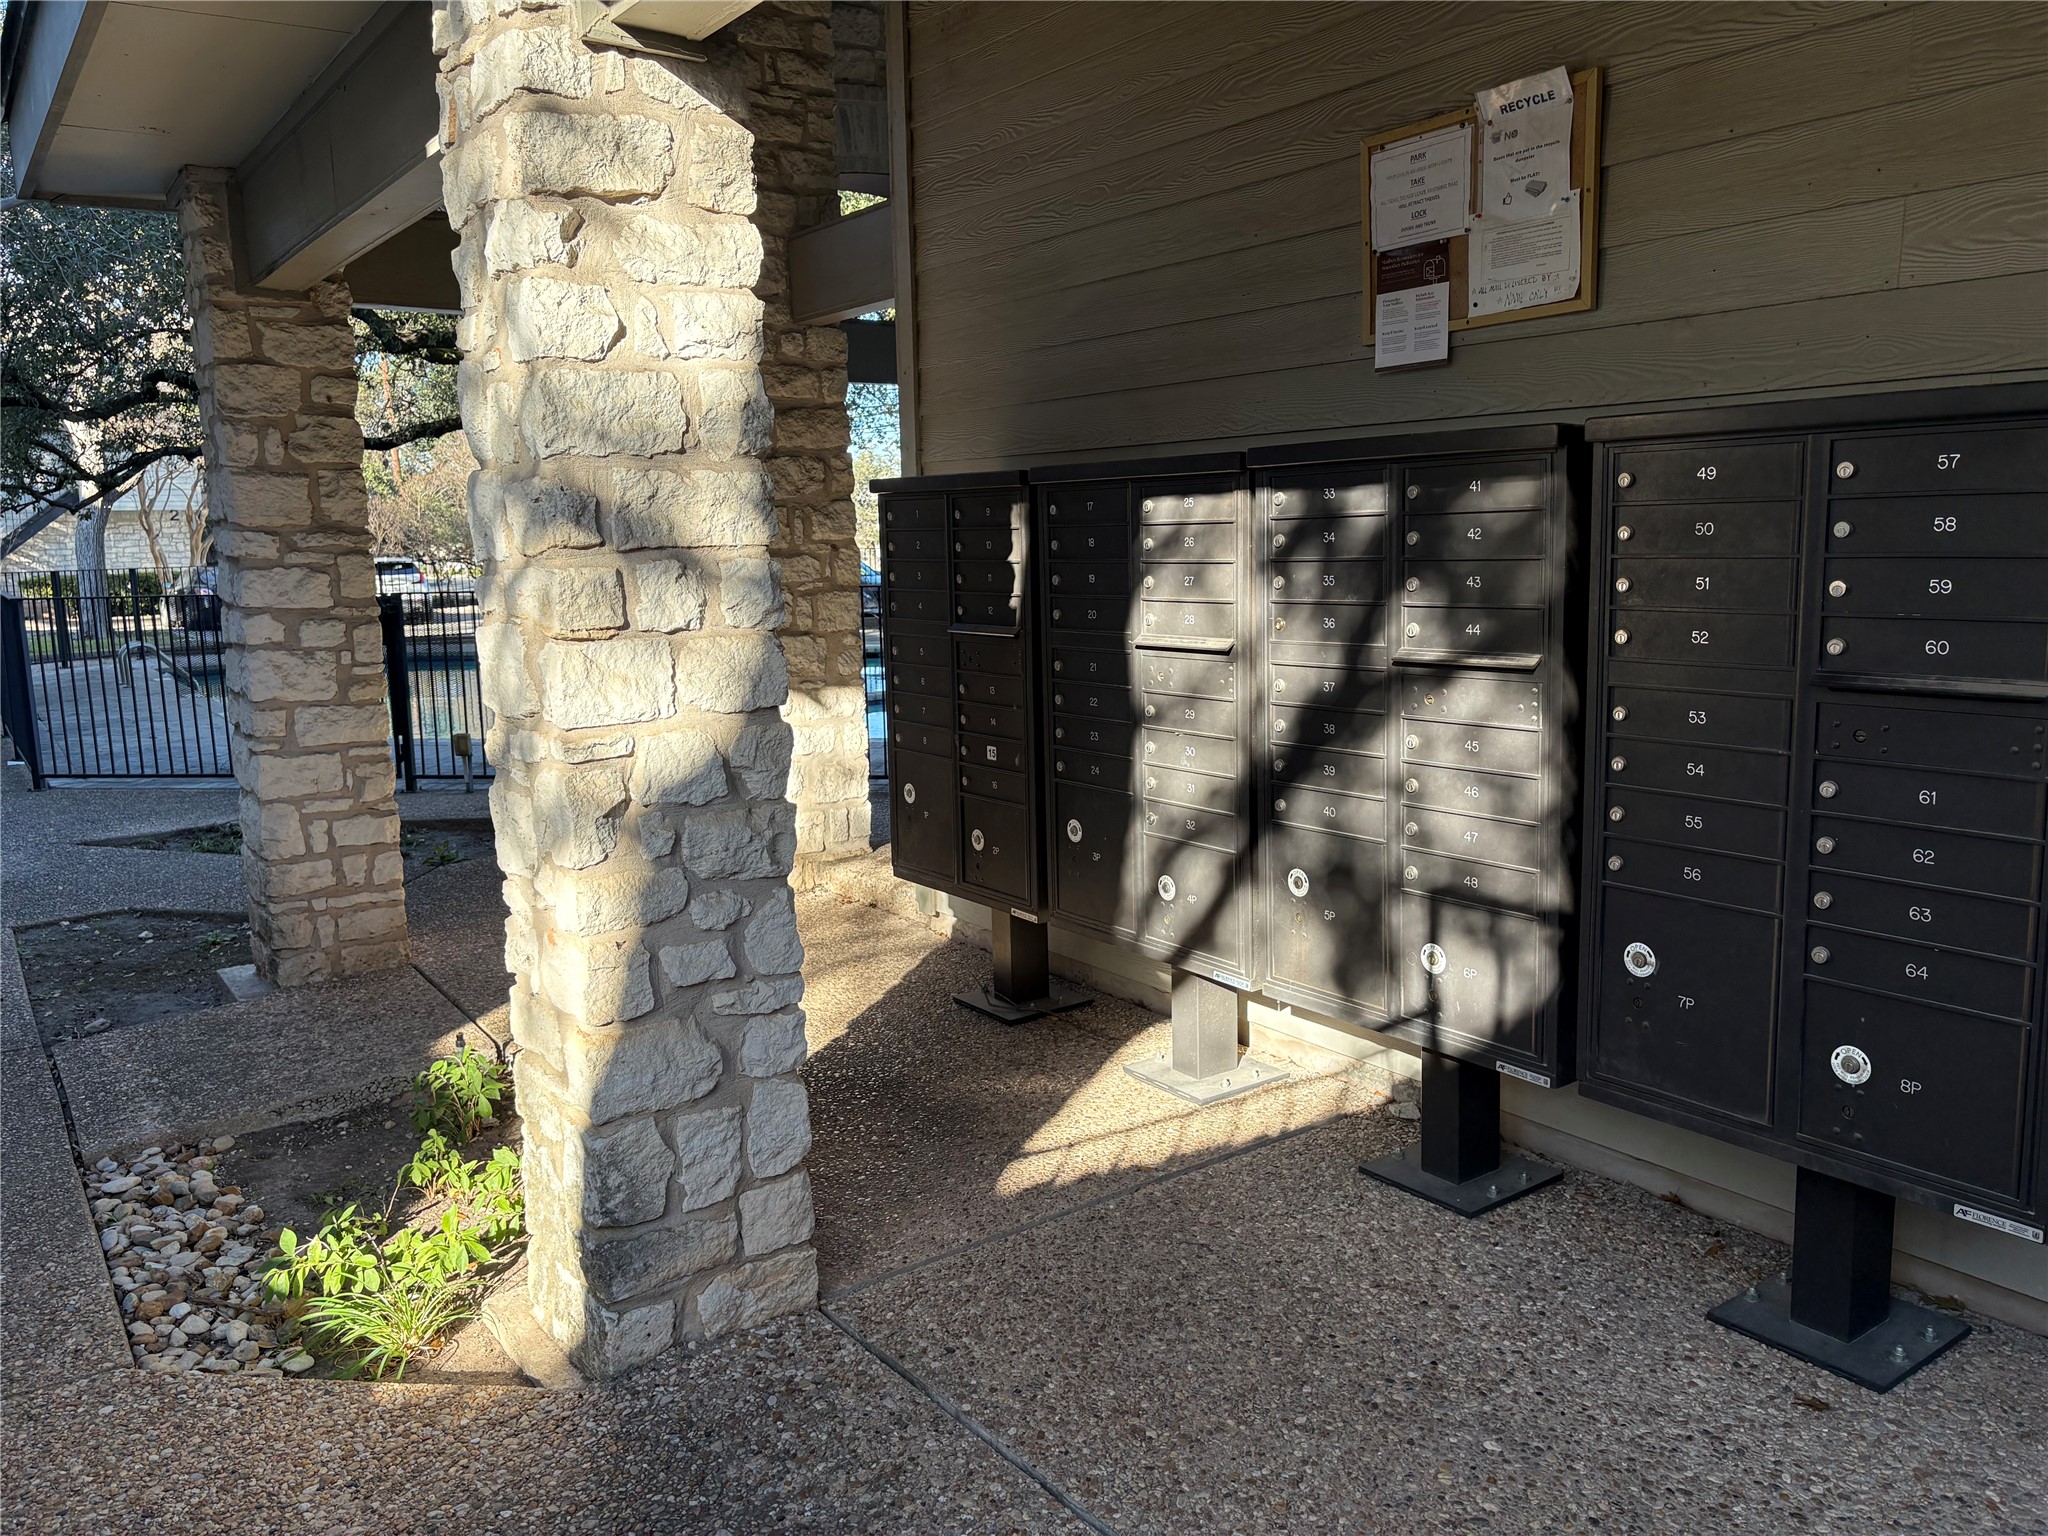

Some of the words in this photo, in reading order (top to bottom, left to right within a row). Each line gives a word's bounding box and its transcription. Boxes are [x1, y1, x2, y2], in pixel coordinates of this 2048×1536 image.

[1500, 90, 1556, 114] RECYCLE
[1410, 152, 1427, 162] PARK
[1410, 176, 1425, 187] TAKE
[1411, 209, 1427, 219] LOCK
[1478, 285, 1487, 294] ALL
[1937, 453, 1961, 470] 57
[1696, 466, 1717, 480] 49
[1469, 480, 1481, 493] 41
[1323, 487, 1336, 500] 33
[1086, 501, 1094, 511] 17
[1183, 497, 1194, 508] 25
[170, 510, 180, 520] 2
[985, 507, 991, 517] 9
[1694, 522, 1715, 536] 50
[1933, 516, 1957, 532] 58
[1322, 531, 1336, 543] 34
[1467, 527, 1482, 540] 42
[985, 540, 992, 550] 10
[1087, 537, 1095, 548] 18
[1184, 536, 1195, 547] 26
[987, 573, 992, 582] 11
[1088, 573, 1096, 584] 19
[1184, 576, 1195, 586] 27
[1322, 575, 1335, 586] 35
[1466, 576, 1482, 588] 43
[1695, 576, 1710, 590] 51
[1928, 579, 1953, 594] 59
[987, 606, 994, 615] 12
[1087, 609, 1097, 620] 20
[1184, 614, 1195, 625] 28
[1323, 617, 1336, 629] 36
[1465, 623, 1481, 636] 44
[1691, 630, 1709, 645] 52
[1925, 639, 1950, 655] 60
[1089, 662, 1097, 672] 21
[989, 686, 996, 695] 13
[1323, 681, 1336, 693] 37
[1089, 697, 1099, 707] 22
[1184, 708, 1195, 720] 29
[1688, 710, 1707, 725] 53
[990, 717, 997, 727] 14
[1323, 723, 1336, 735] 38
[1089, 731, 1099, 741] 23
[1184, 746, 1196, 757] 30
[1464, 740, 1479, 752] 45
[988, 749, 997, 758] 15
[1090, 765, 1100, 775] 24
[1323, 764, 1336, 777] 39
[1686, 762, 1705, 777] 54
[991, 780, 998, 790] 16
[1186, 783, 1195, 794] 31
[1464, 785, 1479, 798] 46
[1918, 789, 1937, 805] 61
[1323, 806, 1336, 818] 40
[1185, 819, 1196, 831] 32
[1684, 815, 1703, 830] 55
[1463, 831, 1479, 843] 47
[992, 846, 1000, 855] 2P
[1092, 851, 1101, 862] 3P
[1912, 848, 1935, 865] 62
[1683, 866, 1702, 881] 56
[1463, 875, 1478, 889] 48
[1186, 894, 1198, 905] 4P
[1323, 909, 1336, 921] 5P
[1909, 906, 1932, 923] 63
[1630, 944, 1647, 952] OPEN
[1463, 967, 1478, 980] 6P
[1905, 963, 1929, 980] 64
[1677, 995, 1695, 1010] 7P
[1840, 1048, 1862, 1058] OPEN
[1900, 1078, 1922, 1095] 8P
[1973, 1212, 2007, 1228] FLORENCE
